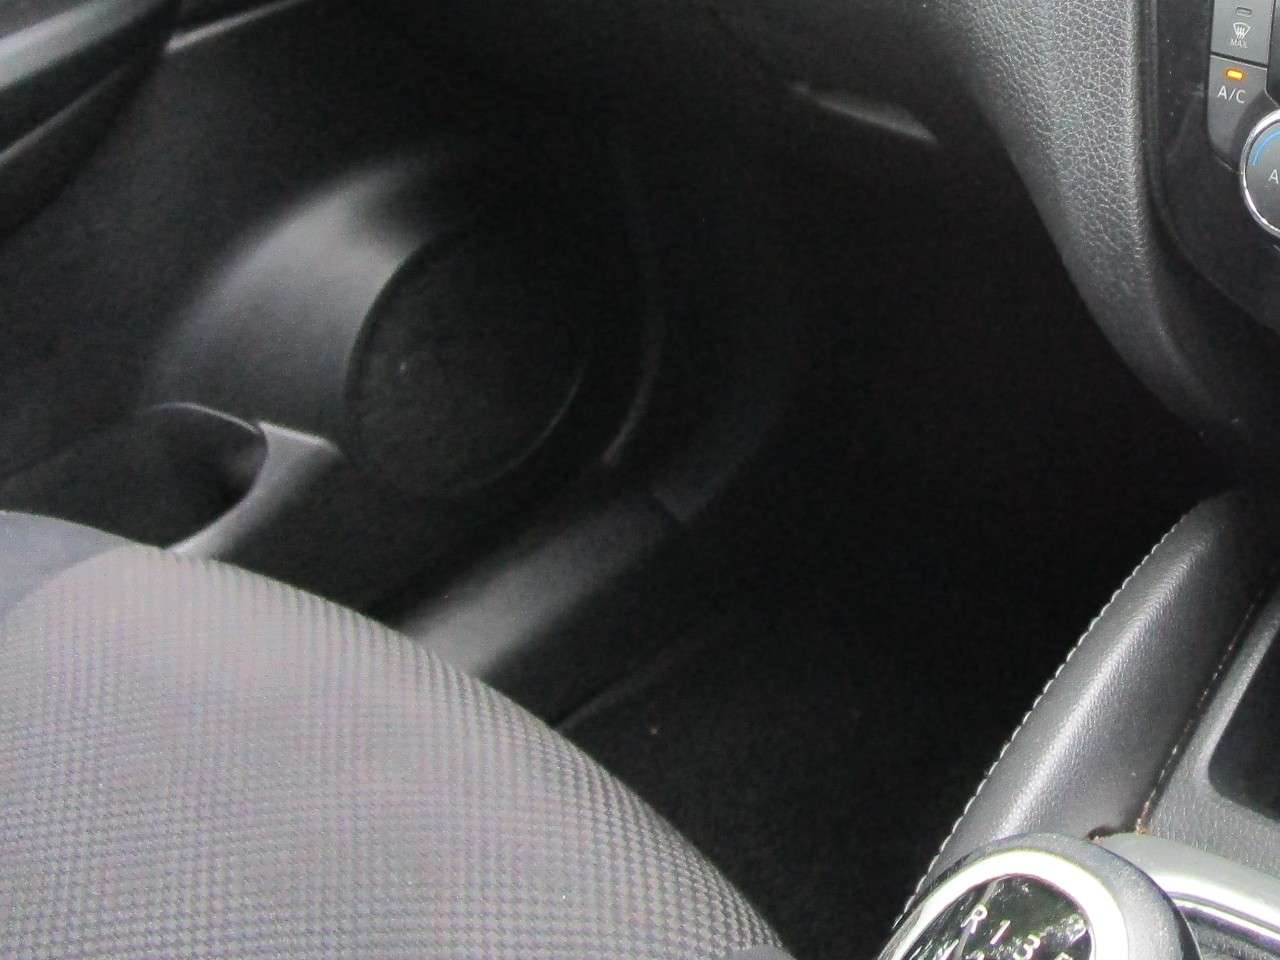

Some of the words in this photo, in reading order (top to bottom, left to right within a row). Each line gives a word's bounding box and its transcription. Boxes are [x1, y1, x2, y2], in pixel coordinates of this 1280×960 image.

[1230, 38, 1249, 50] MAX
[1217, 85, 1248, 104] A/C
[960, 903, 988, 934] R
